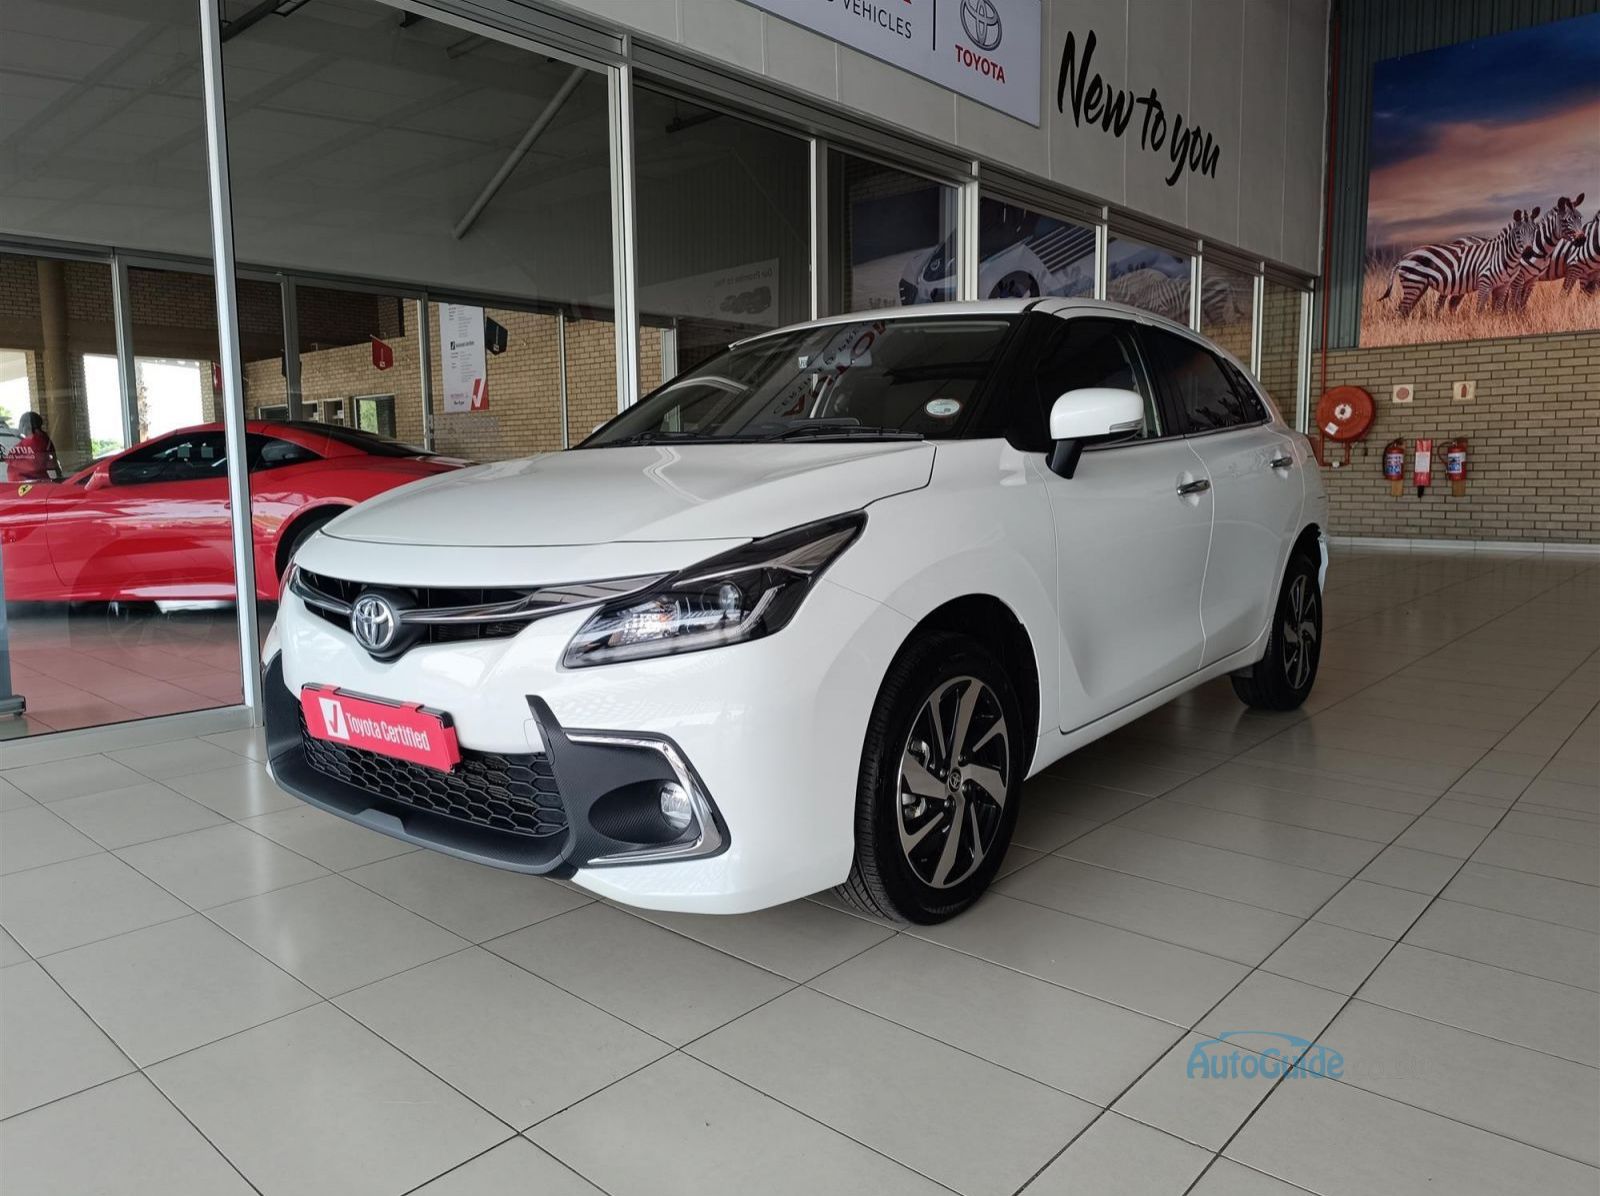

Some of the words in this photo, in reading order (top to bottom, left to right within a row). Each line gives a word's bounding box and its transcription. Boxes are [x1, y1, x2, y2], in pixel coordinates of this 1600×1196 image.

[843, 0, 912, 39] VEHICLES
[955, 44, 1005, 84] TOYOTA
[1057, 30, 1134, 138] New
[1136, 88, 1166, 151] to
[1165, 113, 1220, 186] you
[345, 712, 382, 738] Toyota
[380, 720, 431, 751] Certified
